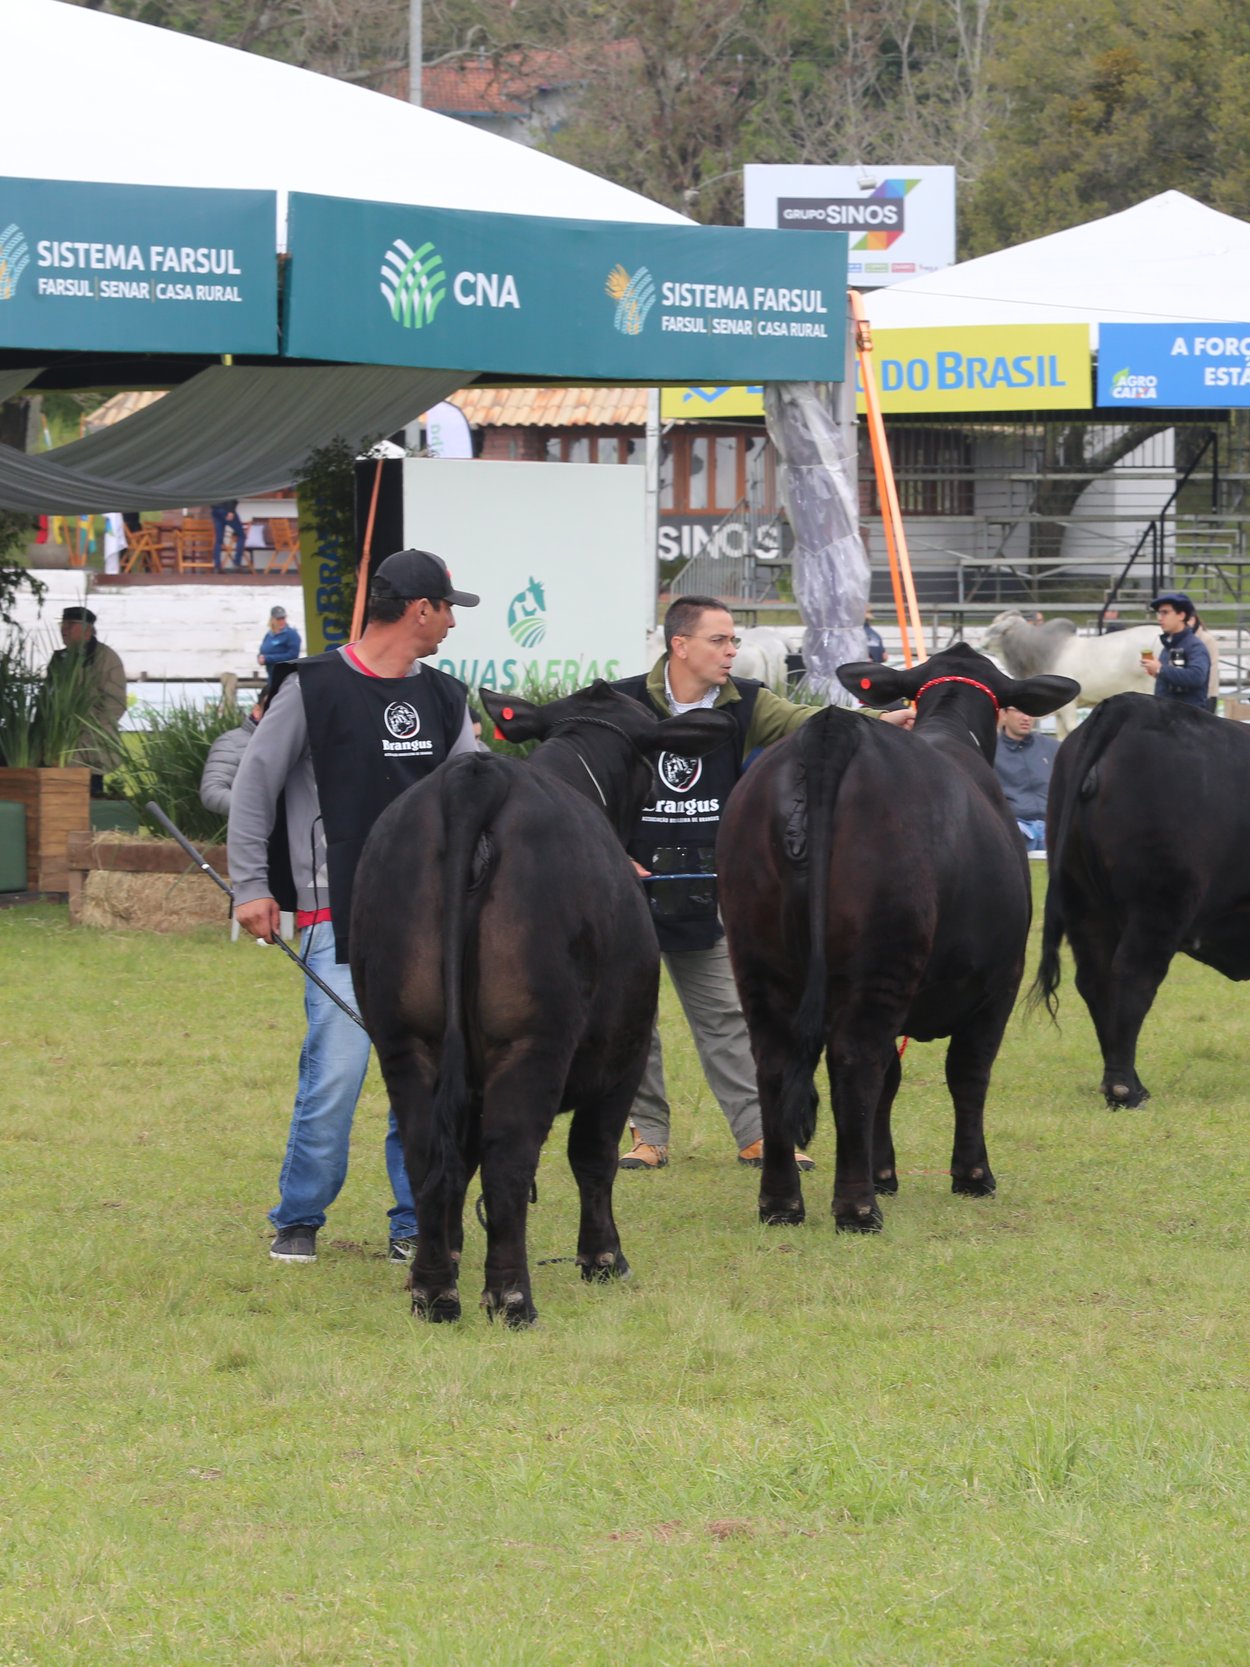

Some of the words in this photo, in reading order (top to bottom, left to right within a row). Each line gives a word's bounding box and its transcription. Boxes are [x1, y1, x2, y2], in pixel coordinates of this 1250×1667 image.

[783, 208, 826, 220] GRUPO
[826, 205, 898, 224] SINOS
[37, 240, 145, 271] SISTEMA
[150, 245, 242, 275] FARSUL
[38, 277, 94, 297] FARSUL
[100, 280, 150, 299] SENAR
[156, 283, 194, 300] CASA
[196, 285, 242, 302] RURAL
[453, 271, 520, 309] CNA
[662, 282, 749, 310] SISTEMA
[754, 287, 828, 313] FARSUL
[662, 316, 707, 334] FARSUL
[712, 318, 752, 336] SENAR
[758, 321, 788, 337] CASA
[790, 322, 828, 338] RURAL
[1171, 338, 1189, 356] A
[881, 358, 929, 391] DO
[936, 351, 1066, 390] BRASIL
[1115, 375, 1157, 387] AGRO
[1112, 387, 1157, 399] CAIXA
[658, 523, 780, 561] SINOS
[382, 739, 433, 751] Brangus
[641, 799, 719, 815] rangus
